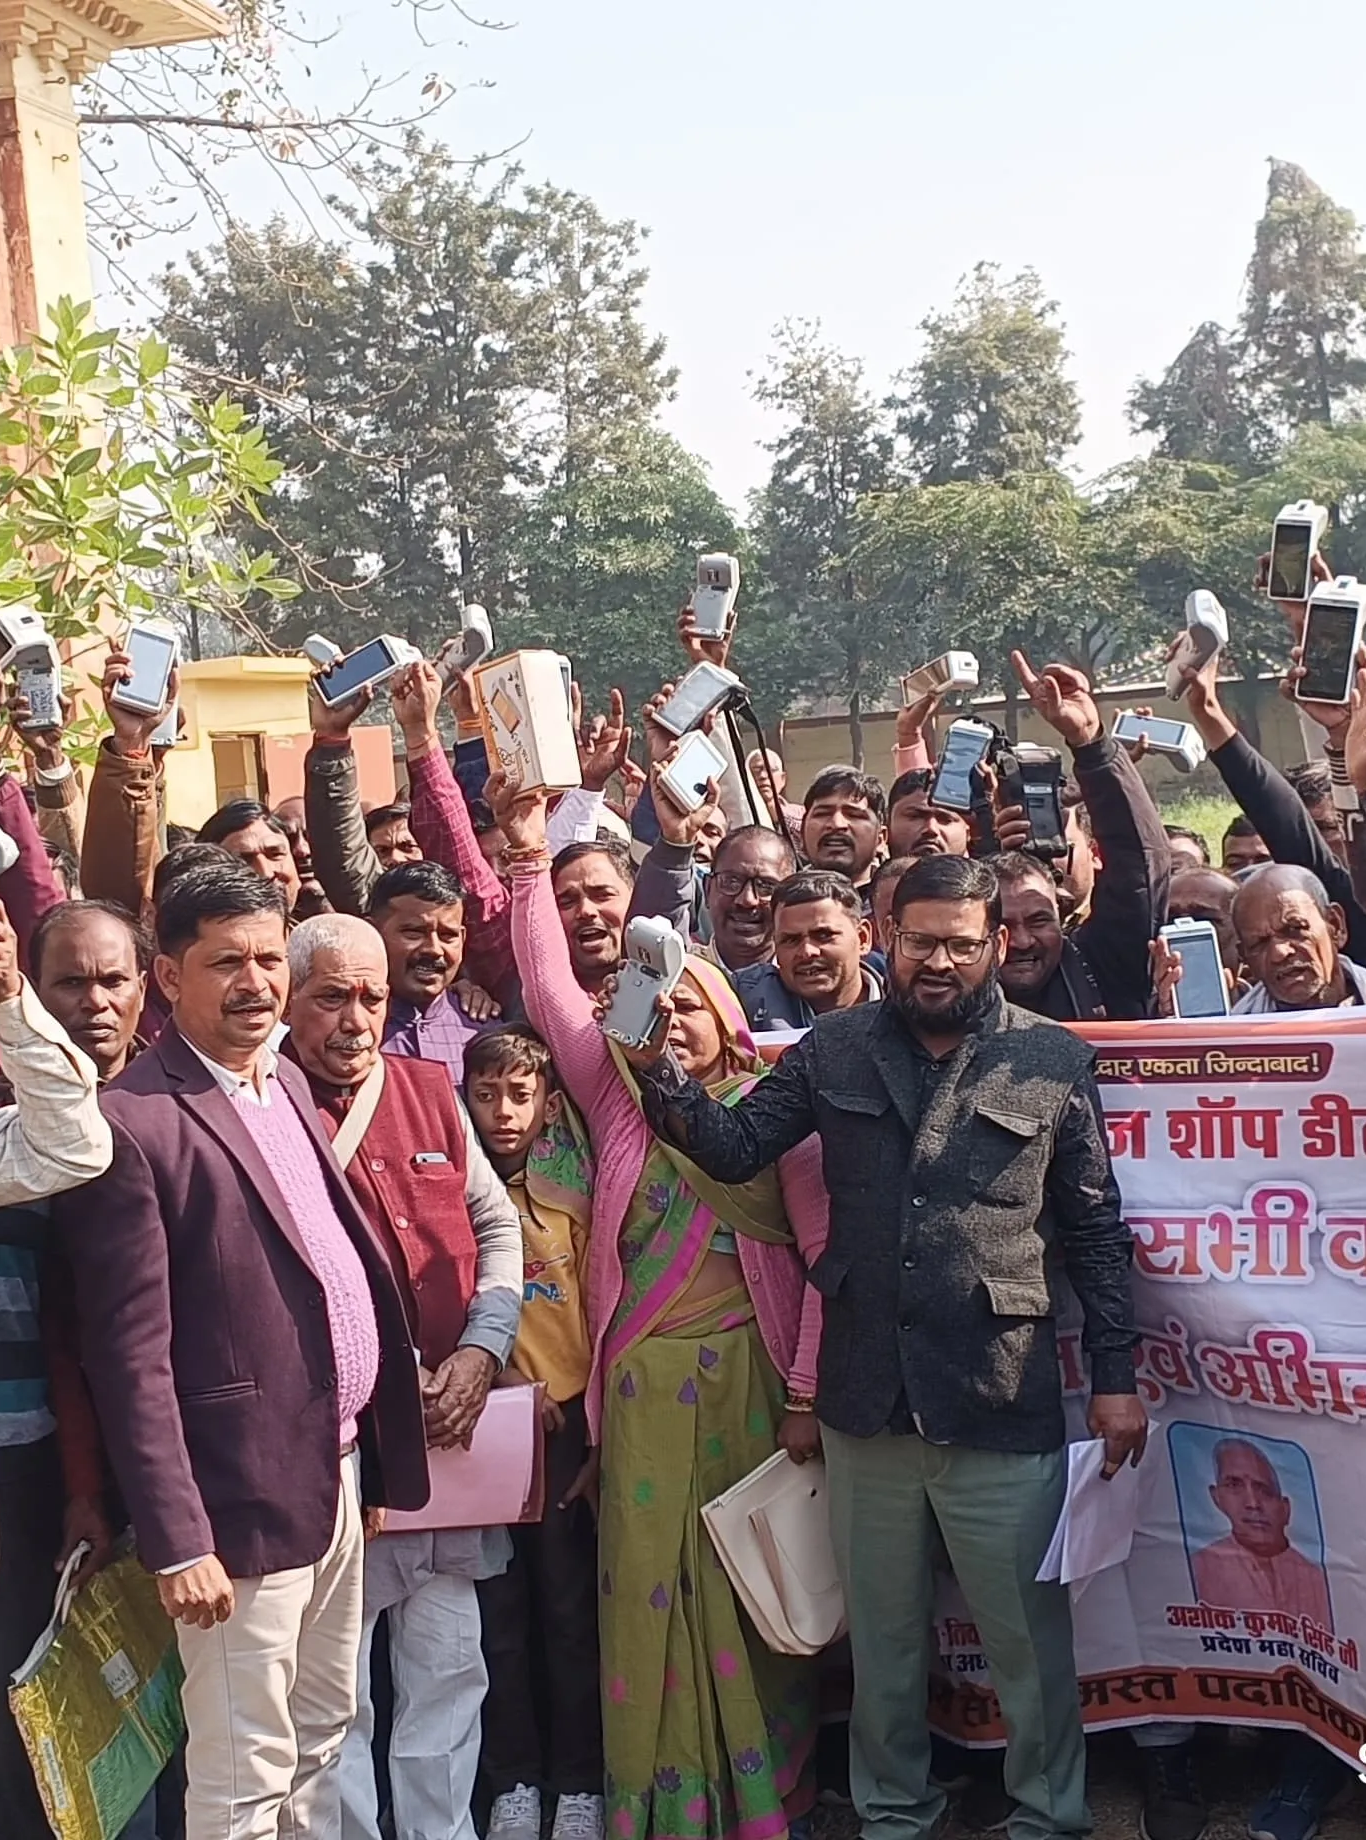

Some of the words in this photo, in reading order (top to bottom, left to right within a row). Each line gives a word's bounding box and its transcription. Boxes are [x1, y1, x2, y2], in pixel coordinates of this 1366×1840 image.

[1094, 1059, 1135, 1077] दार
[1137, 1057, 1200, 1077] एकता
[1205, 1051, 1319, 1075] जिन्दाबाद!
[1103, 1110, 1151, 1158] ज
[1166, 1096, 1283, 1158] शॉप
[1125, 1189, 1309, 1278] सभी
[1166, 1602, 1235, 1630] अशोक
[1241, 1611, 1299, 1638] कुमार
[1301, 1615, 1336, 1657] सिंह
[1338, 1638, 1359, 1672] जी
[1201, 1631, 1252, 1655] प्रदेश
[1258, 1640, 1295, 1660] महा
[1299, 1647, 1340, 1684] सचिव
